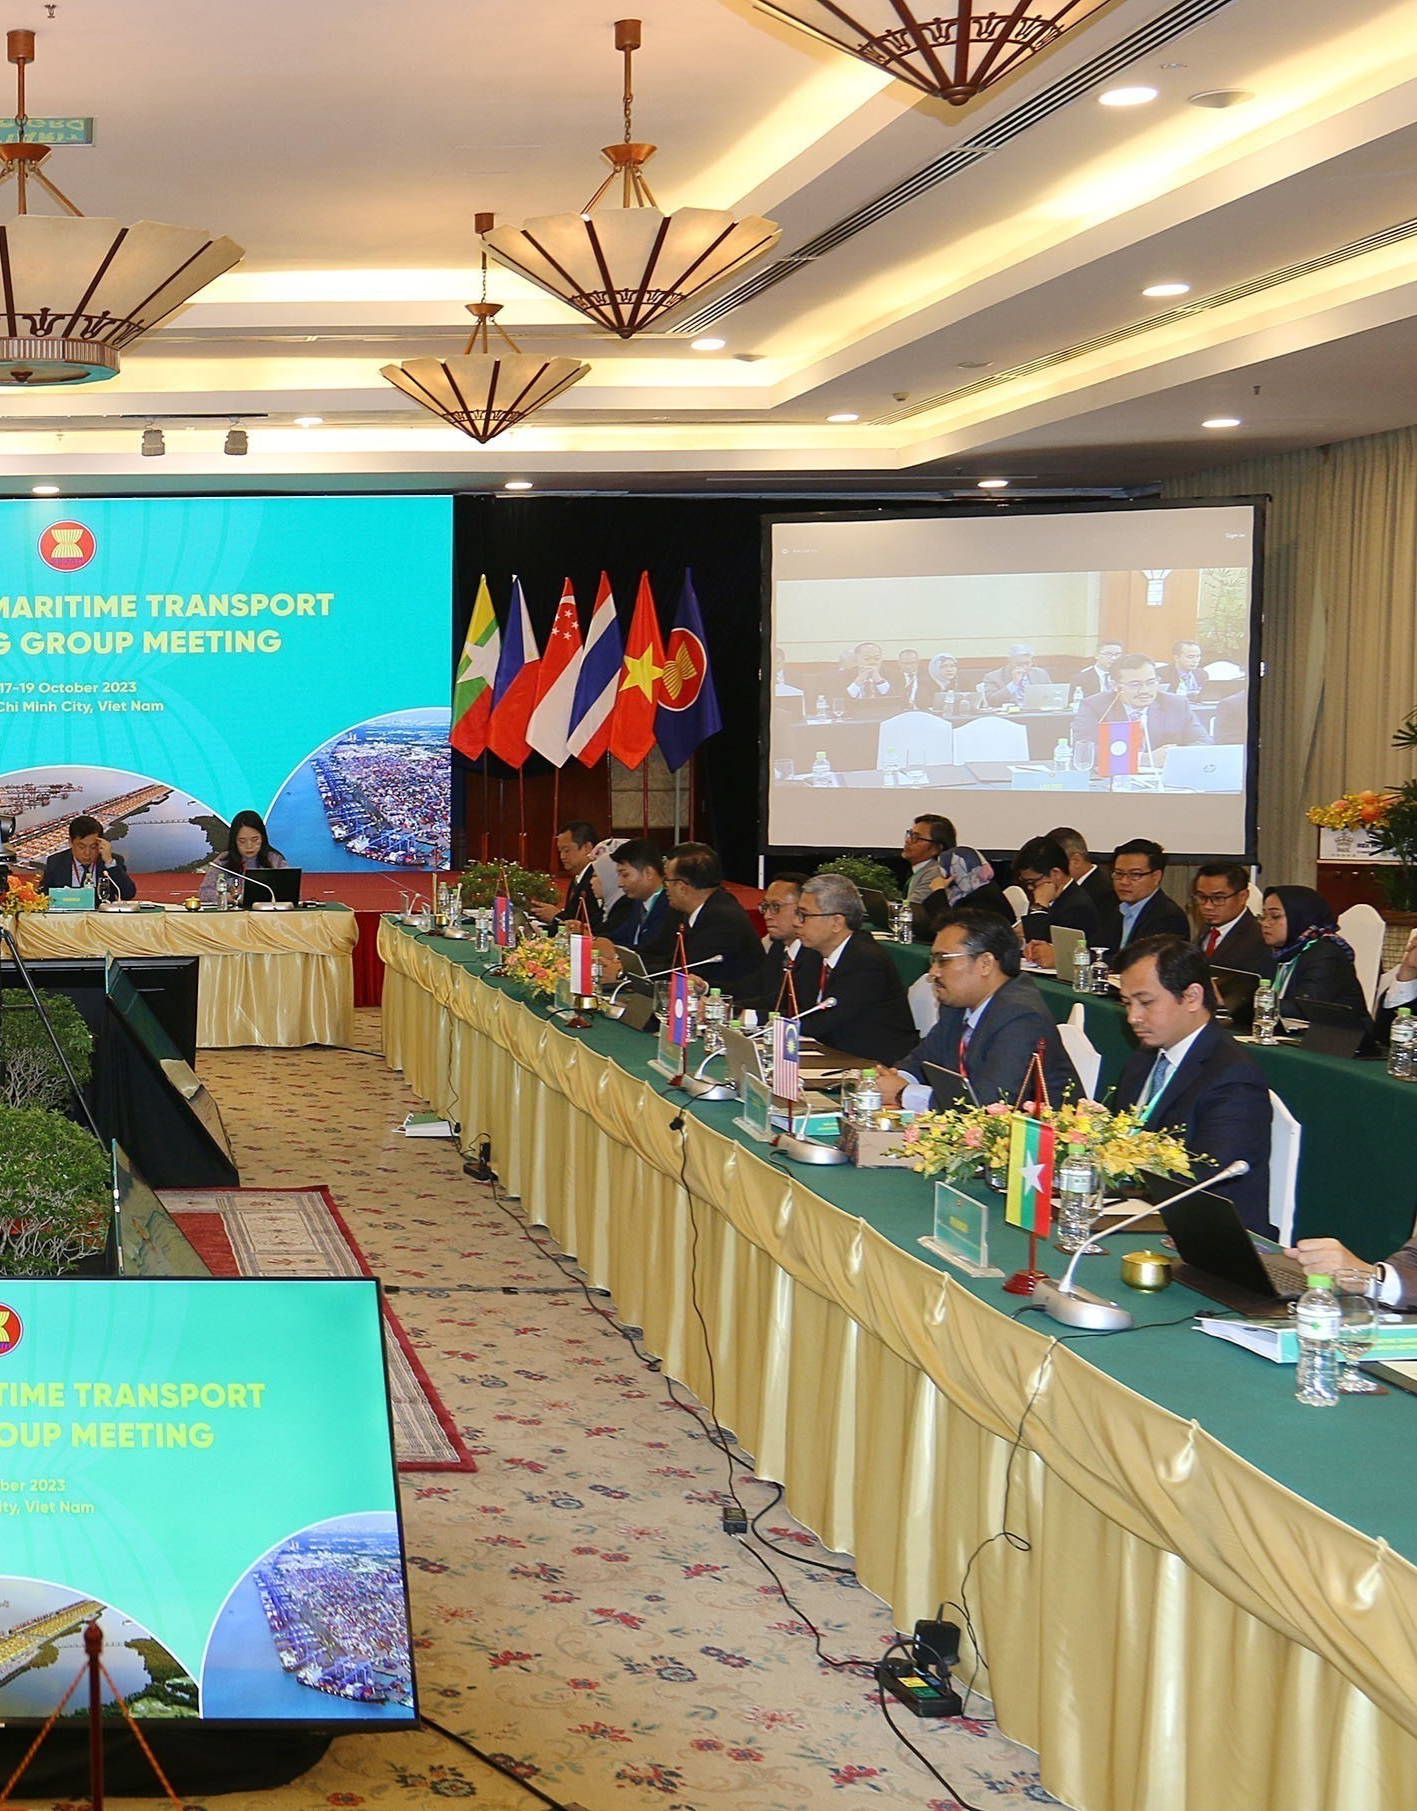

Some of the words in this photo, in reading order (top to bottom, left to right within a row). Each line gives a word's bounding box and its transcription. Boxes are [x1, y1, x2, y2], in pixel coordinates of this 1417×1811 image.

[146, 593, 334, 617] TRANSPORT
[20, 631, 134, 655] GROUP
[143, 630, 281, 653] MEETING
[38, 681, 99, 694] October
[103, 681, 137, 694] 2023
[22, 701, 58, 712] Minh
[61, 701, 94, 715] City,
[98, 700, 127, 712] Viet
[130, 700, 165, 712] Nam
[73, 1383, 266, 1408] TRANSPORT
[72, 1422, 214, 1448] MEETING
[29, 1478, 66, 1492] 2023
[24, 1500, 56, 1514] Viet
[59, 1500, 95, 1514] Nam
